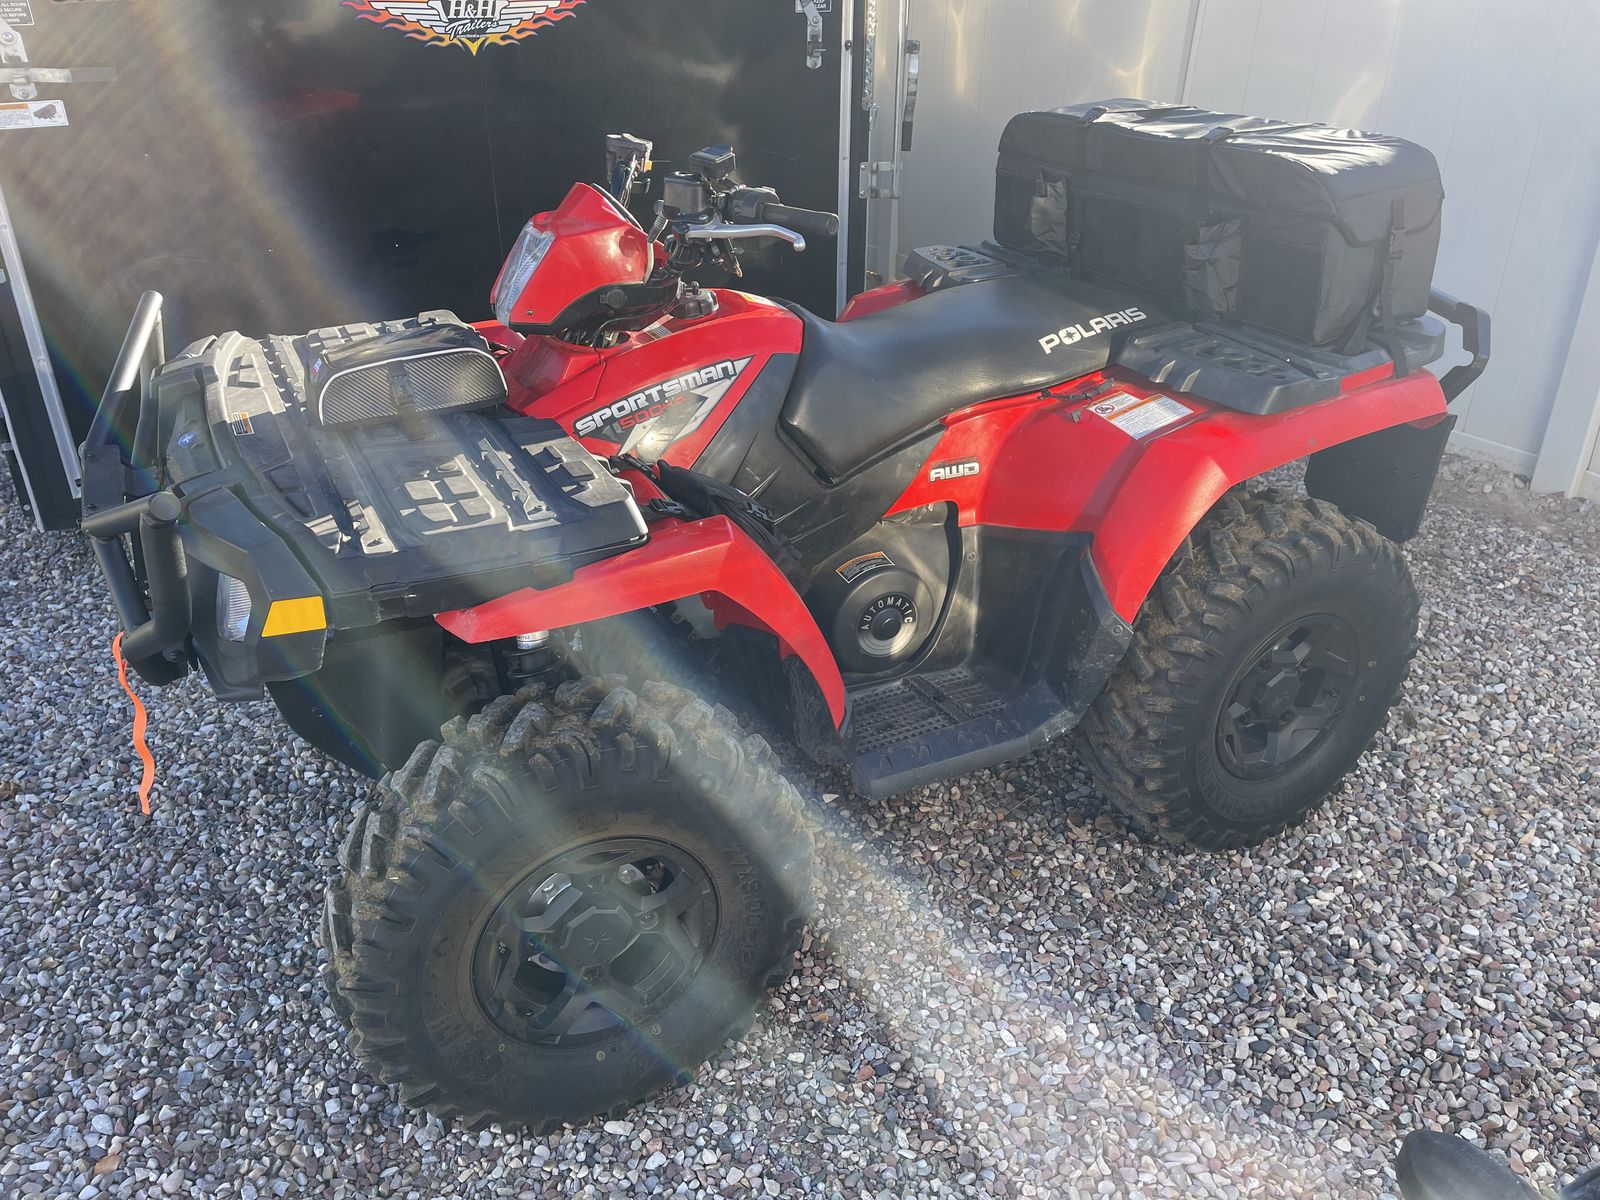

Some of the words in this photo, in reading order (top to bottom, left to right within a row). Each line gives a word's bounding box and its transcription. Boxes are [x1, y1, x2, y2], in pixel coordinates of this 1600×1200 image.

[448, 0, 494, 18] H&H
[445, 19, 498, 40] Trailers
[1038, 307, 1147, 354] POLARIS
[575, 361, 735, 436] SPORTSMAN
[620, 403, 665, 429] 500
[929, 462, 980, 482] AWD
[861, 597, 914, 630] AUTOMATIC
